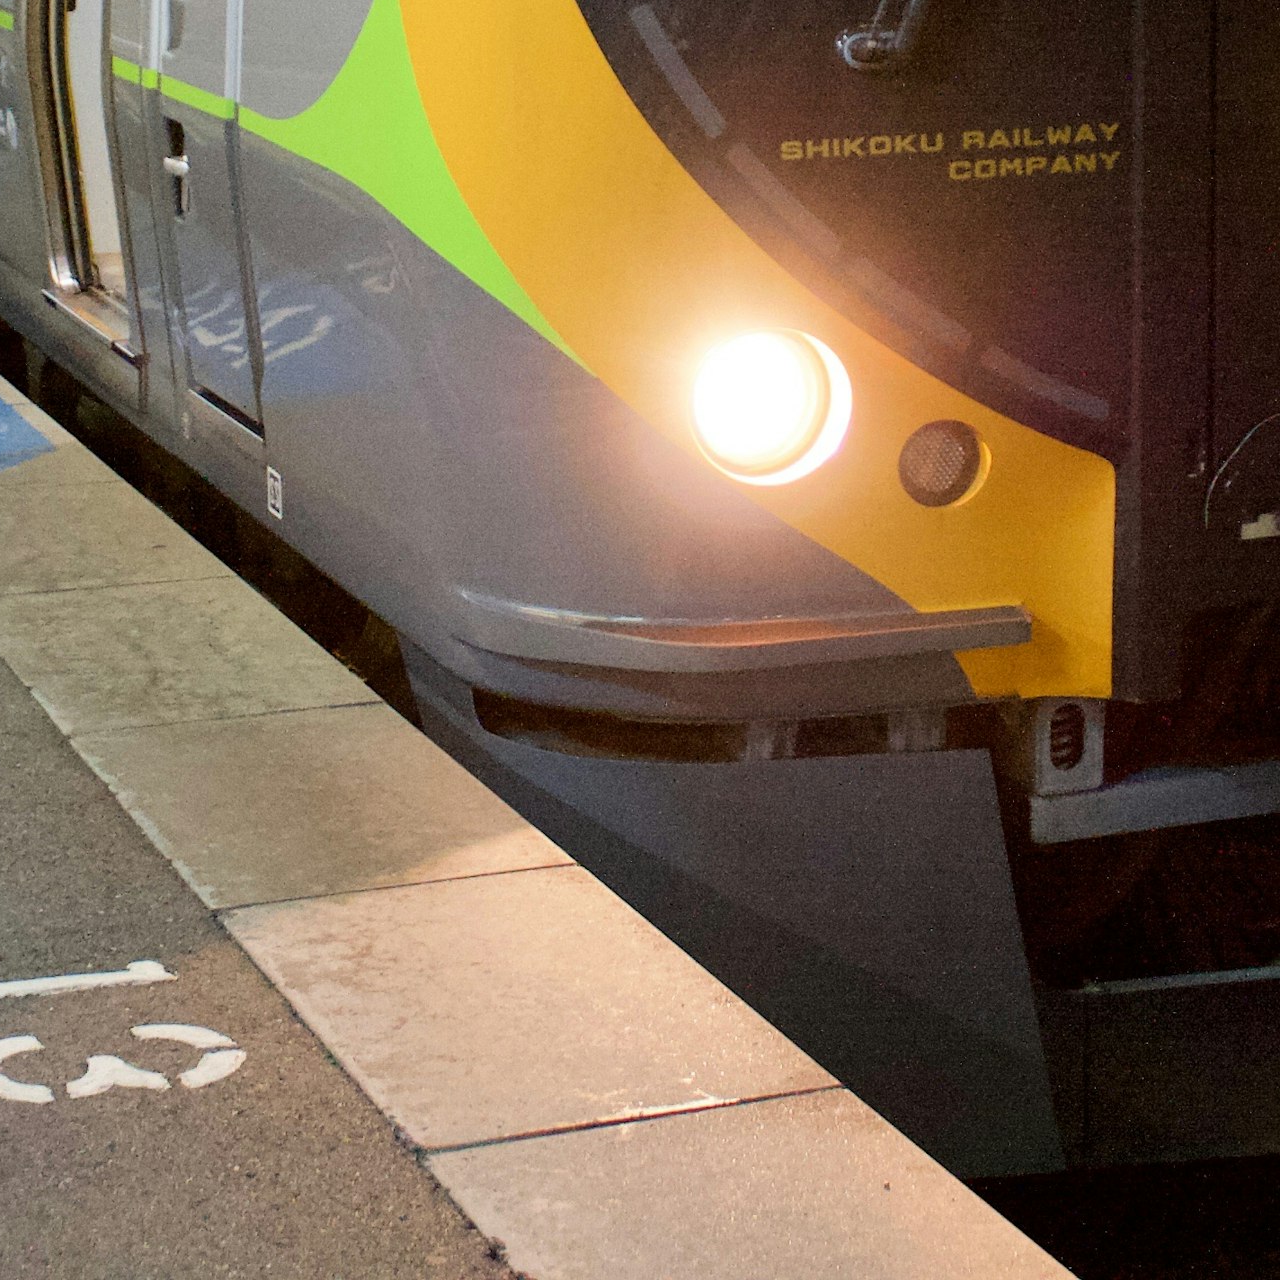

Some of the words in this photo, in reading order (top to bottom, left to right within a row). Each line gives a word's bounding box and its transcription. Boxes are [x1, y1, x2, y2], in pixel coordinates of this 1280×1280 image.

[780, 132, 943, 161] SHIKOKU
[962, 122, 1119, 151] RAILWAY
[949, 151, 1120, 181] COMPANY
